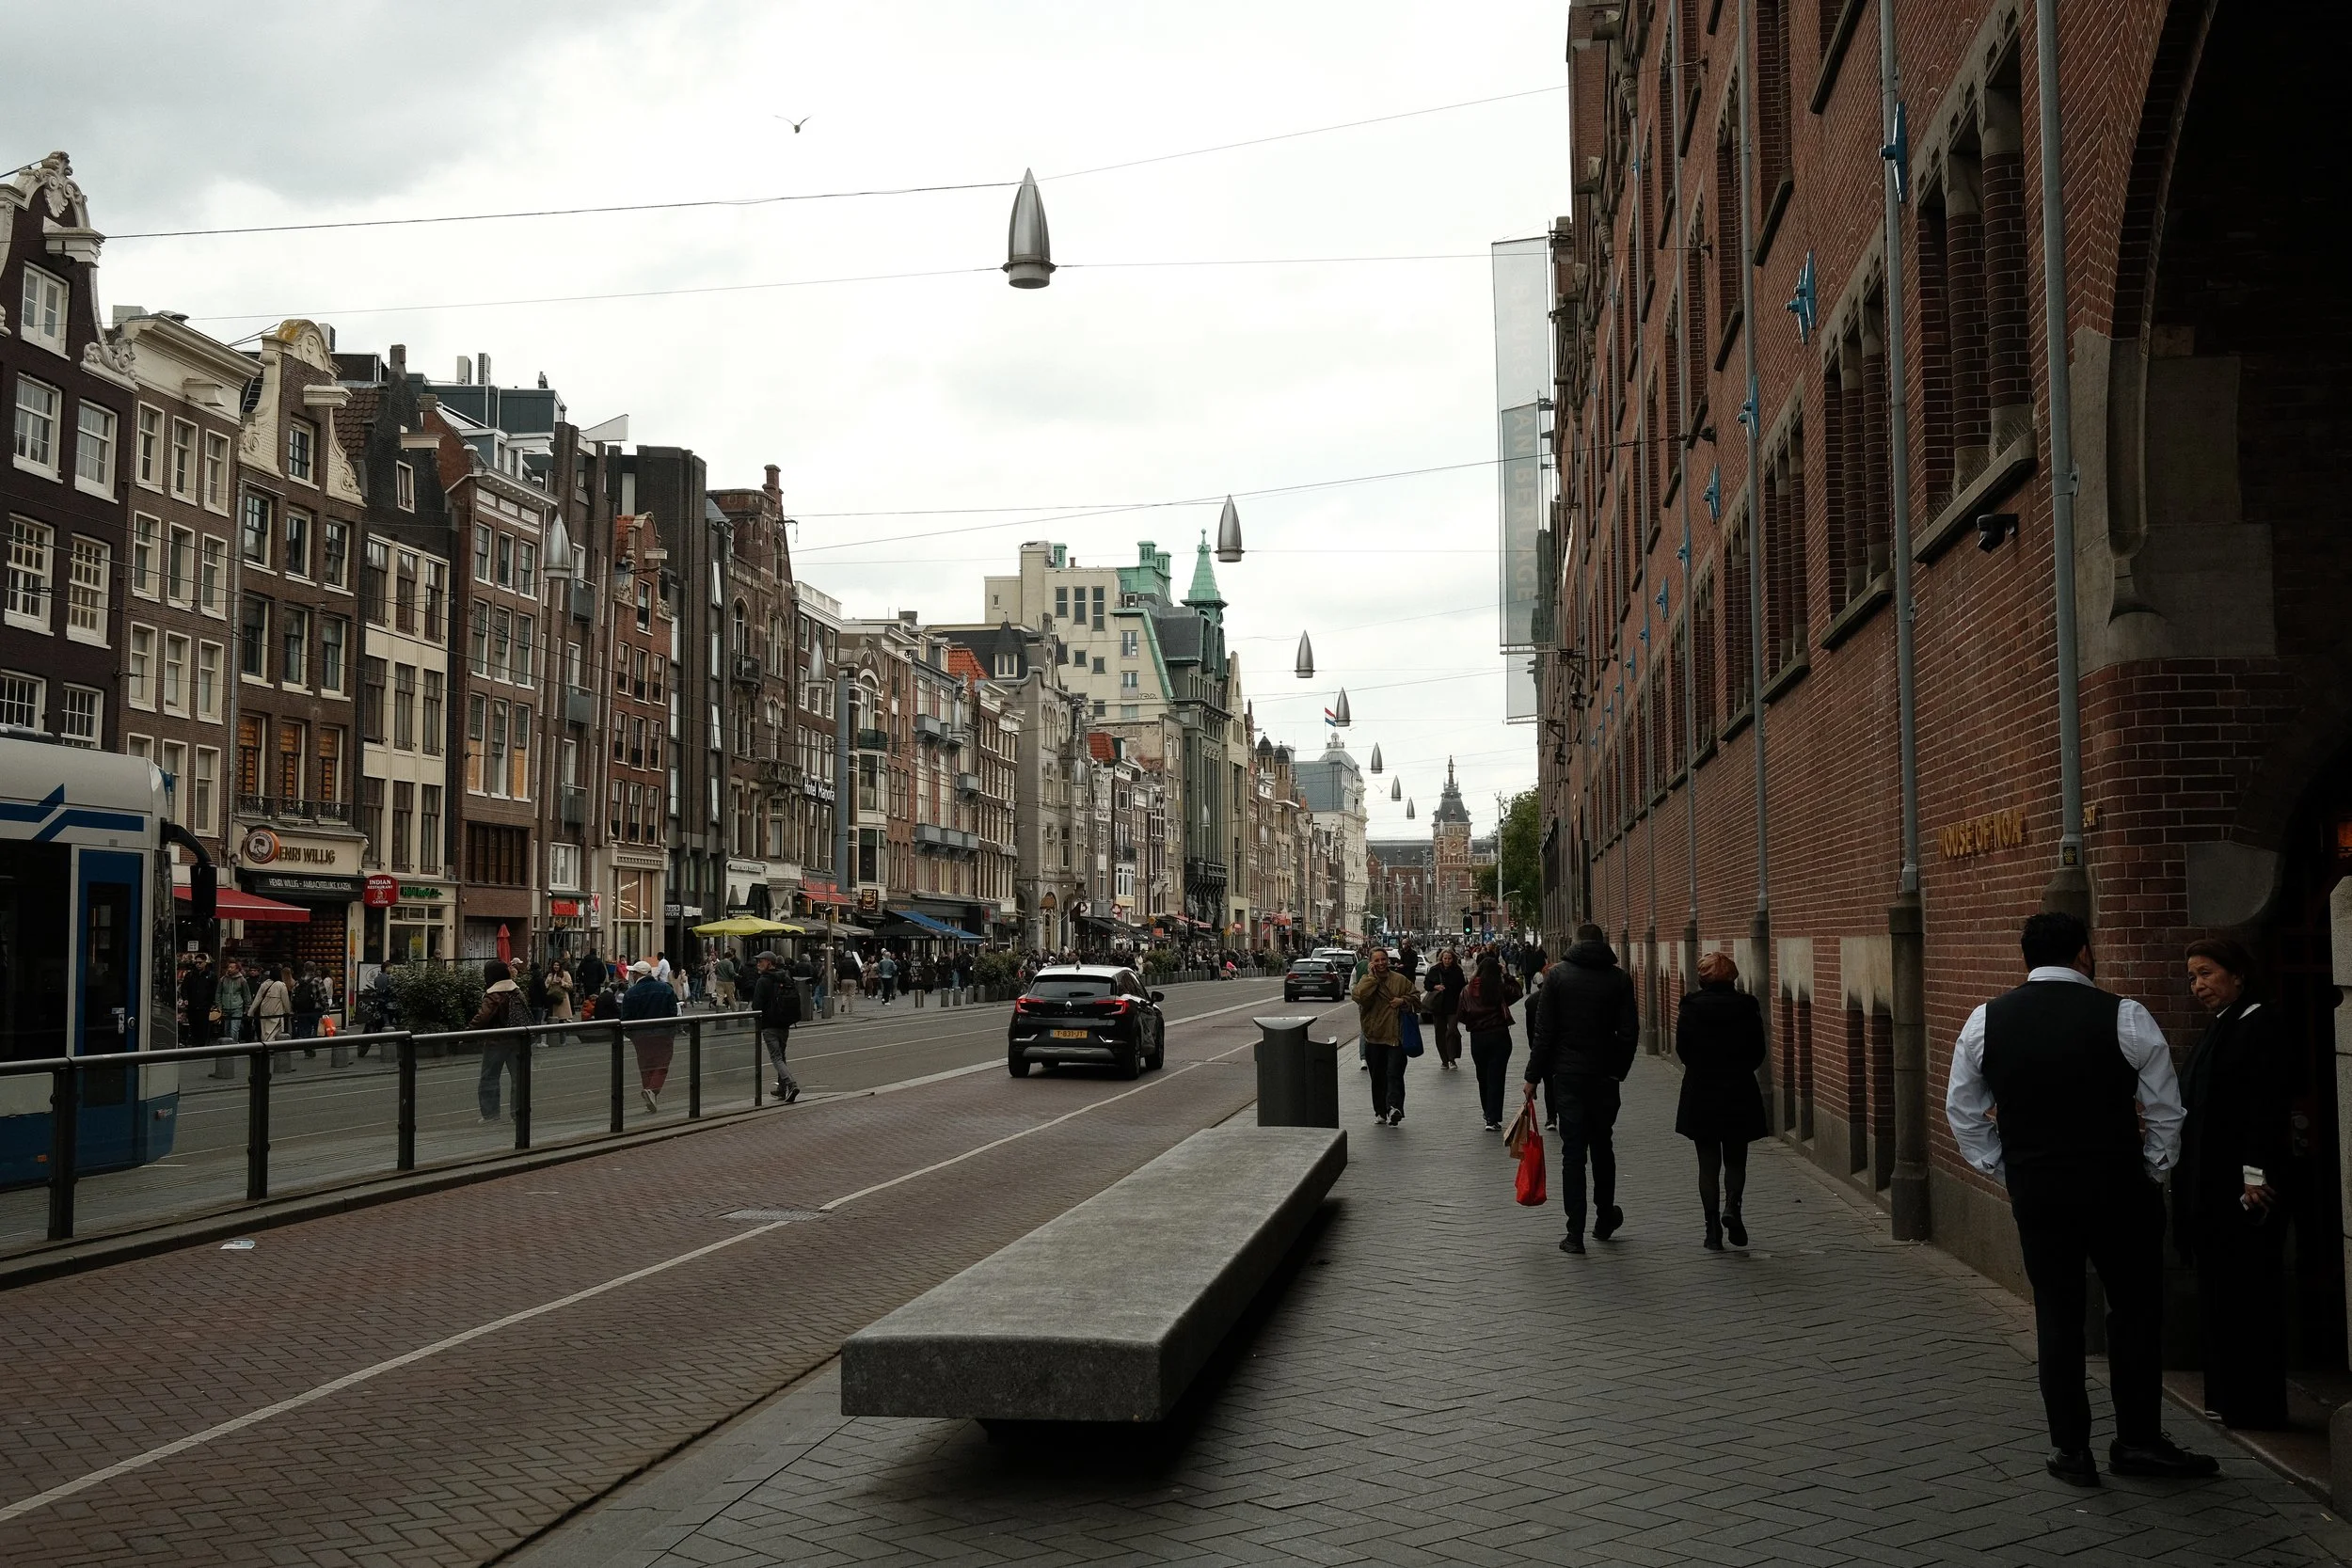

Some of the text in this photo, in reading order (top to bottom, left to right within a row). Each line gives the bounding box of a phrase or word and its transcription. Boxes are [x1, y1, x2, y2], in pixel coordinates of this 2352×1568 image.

[1515, 467, 1536, 602] BERLAGE
[803, 778, 817, 797] Hotel
[1939, 821, 1973, 858] HOUSE
[1975, 816, 1992, 851] OF
[278, 846, 301, 863] ENRI
[303, 847, 336, 864] WILLIG
[268, 878, 284, 887] HENRI
[284, 879, 299, 888] WILLIG
